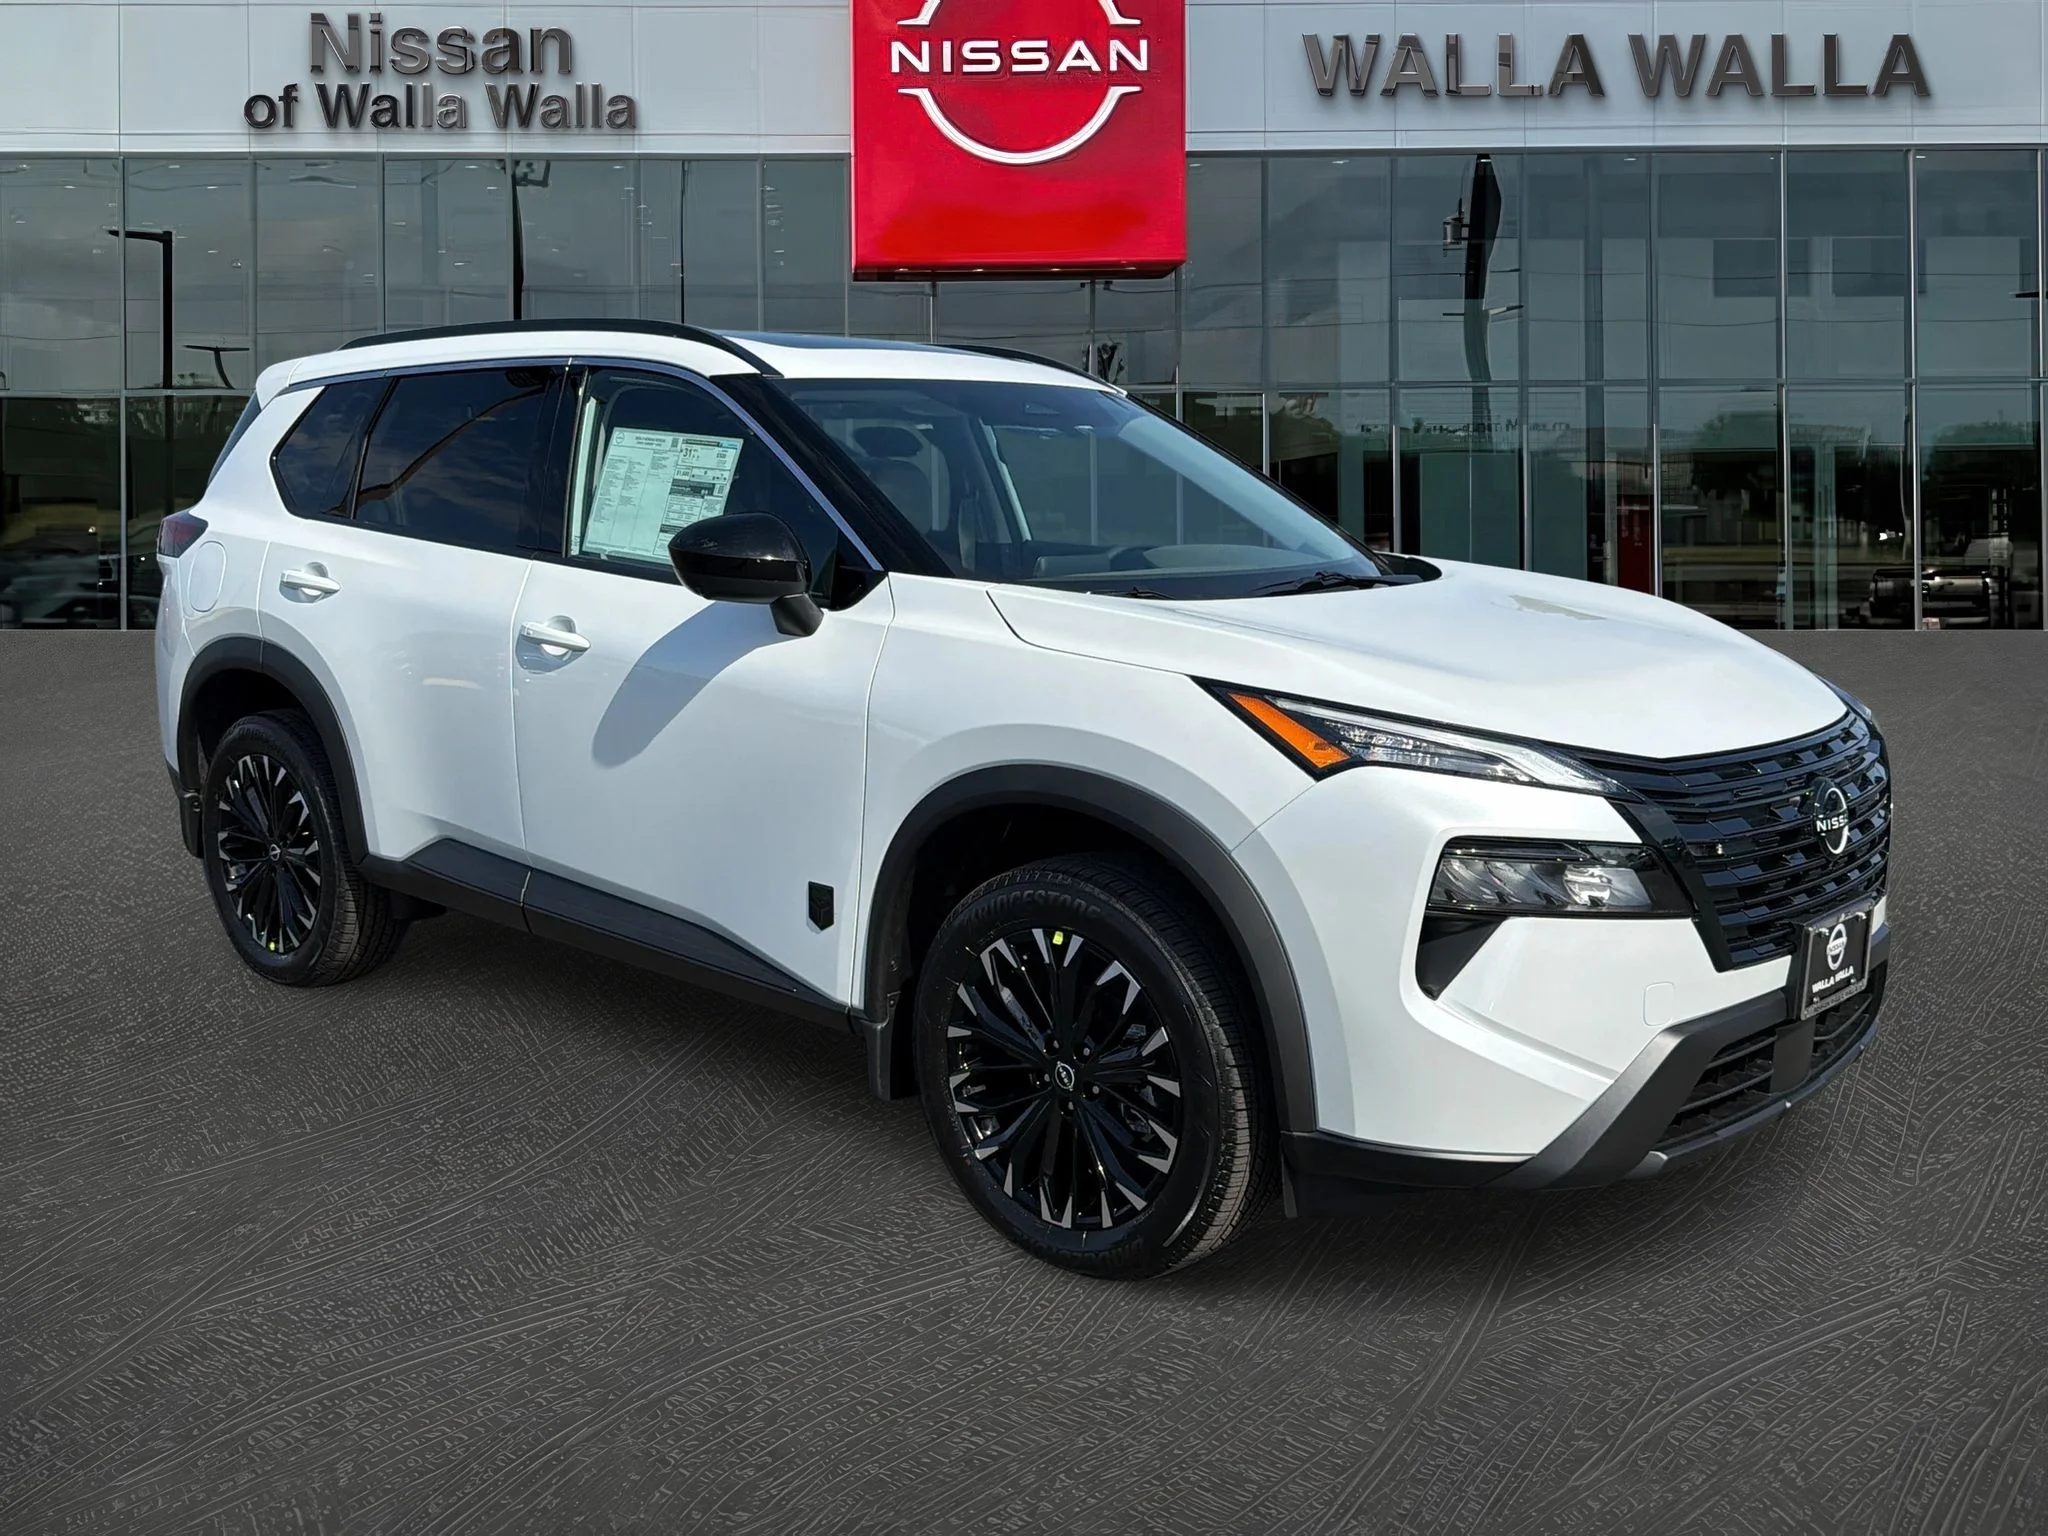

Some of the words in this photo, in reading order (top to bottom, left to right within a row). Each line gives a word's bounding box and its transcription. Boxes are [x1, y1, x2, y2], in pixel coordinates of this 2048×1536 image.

[309, 12, 572, 74] Nissan
[890, 39, 1148, 73] NISSAN
[1302, 32, 1605, 96] WALLA
[1627, 32, 1930, 96] WALLA
[243, 83, 298, 129] of
[314, 81, 468, 129] Walla
[484, 82, 637, 129] Walla
[1816, 814, 1849, 832] NISS
[1811, 976, 1835, 993] WALLA
